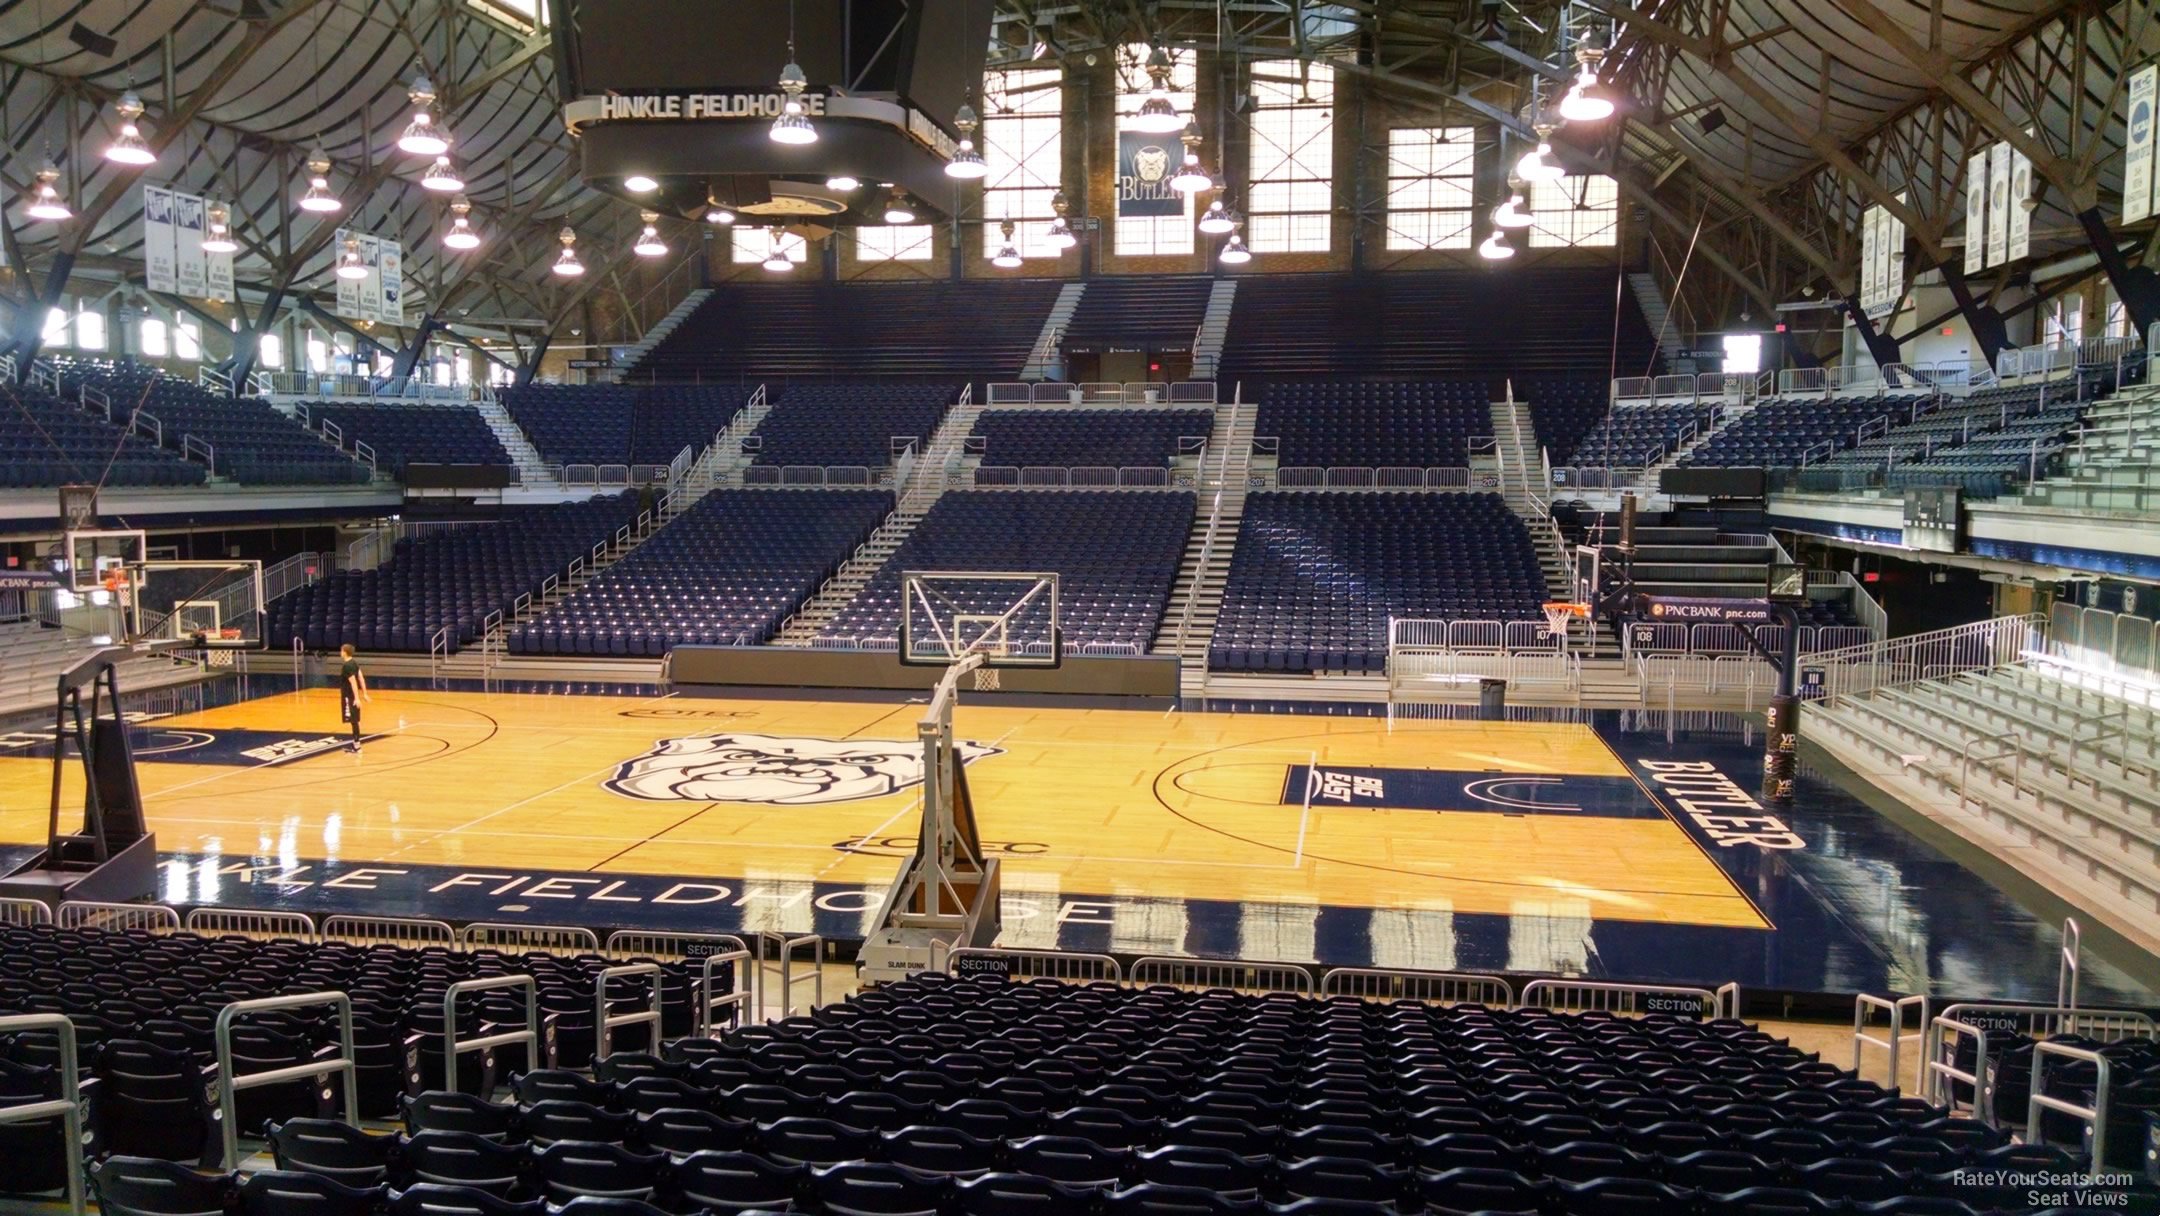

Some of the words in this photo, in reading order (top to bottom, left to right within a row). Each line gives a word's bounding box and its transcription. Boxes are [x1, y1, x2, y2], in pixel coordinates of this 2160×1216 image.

[601, 95, 681, 119] HINKLE
[1483, 479, 1497, 487] 207
[1726, 610, 1767, 619] pnc.com
[1537, 630, 1550, 640] 107
[1637, 631, 1653, 642] 108
[1322, 771, 1352, 803] EAST
[1352, 775, 1384, 799] BIG
[1637, 759, 1807, 849] BUTLER
[430, 873, 1121, 924] FIELDHOSE
[687, 944, 732, 955] SECTION
[888, 961, 906, 969] SLAM
[907, 961, 926, 970] DUNK
[961, 959, 1008, 971] SECTION
[1647, 998, 1702, 1012] SECTION
[1961, 1016, 2017, 1030] SECTION
